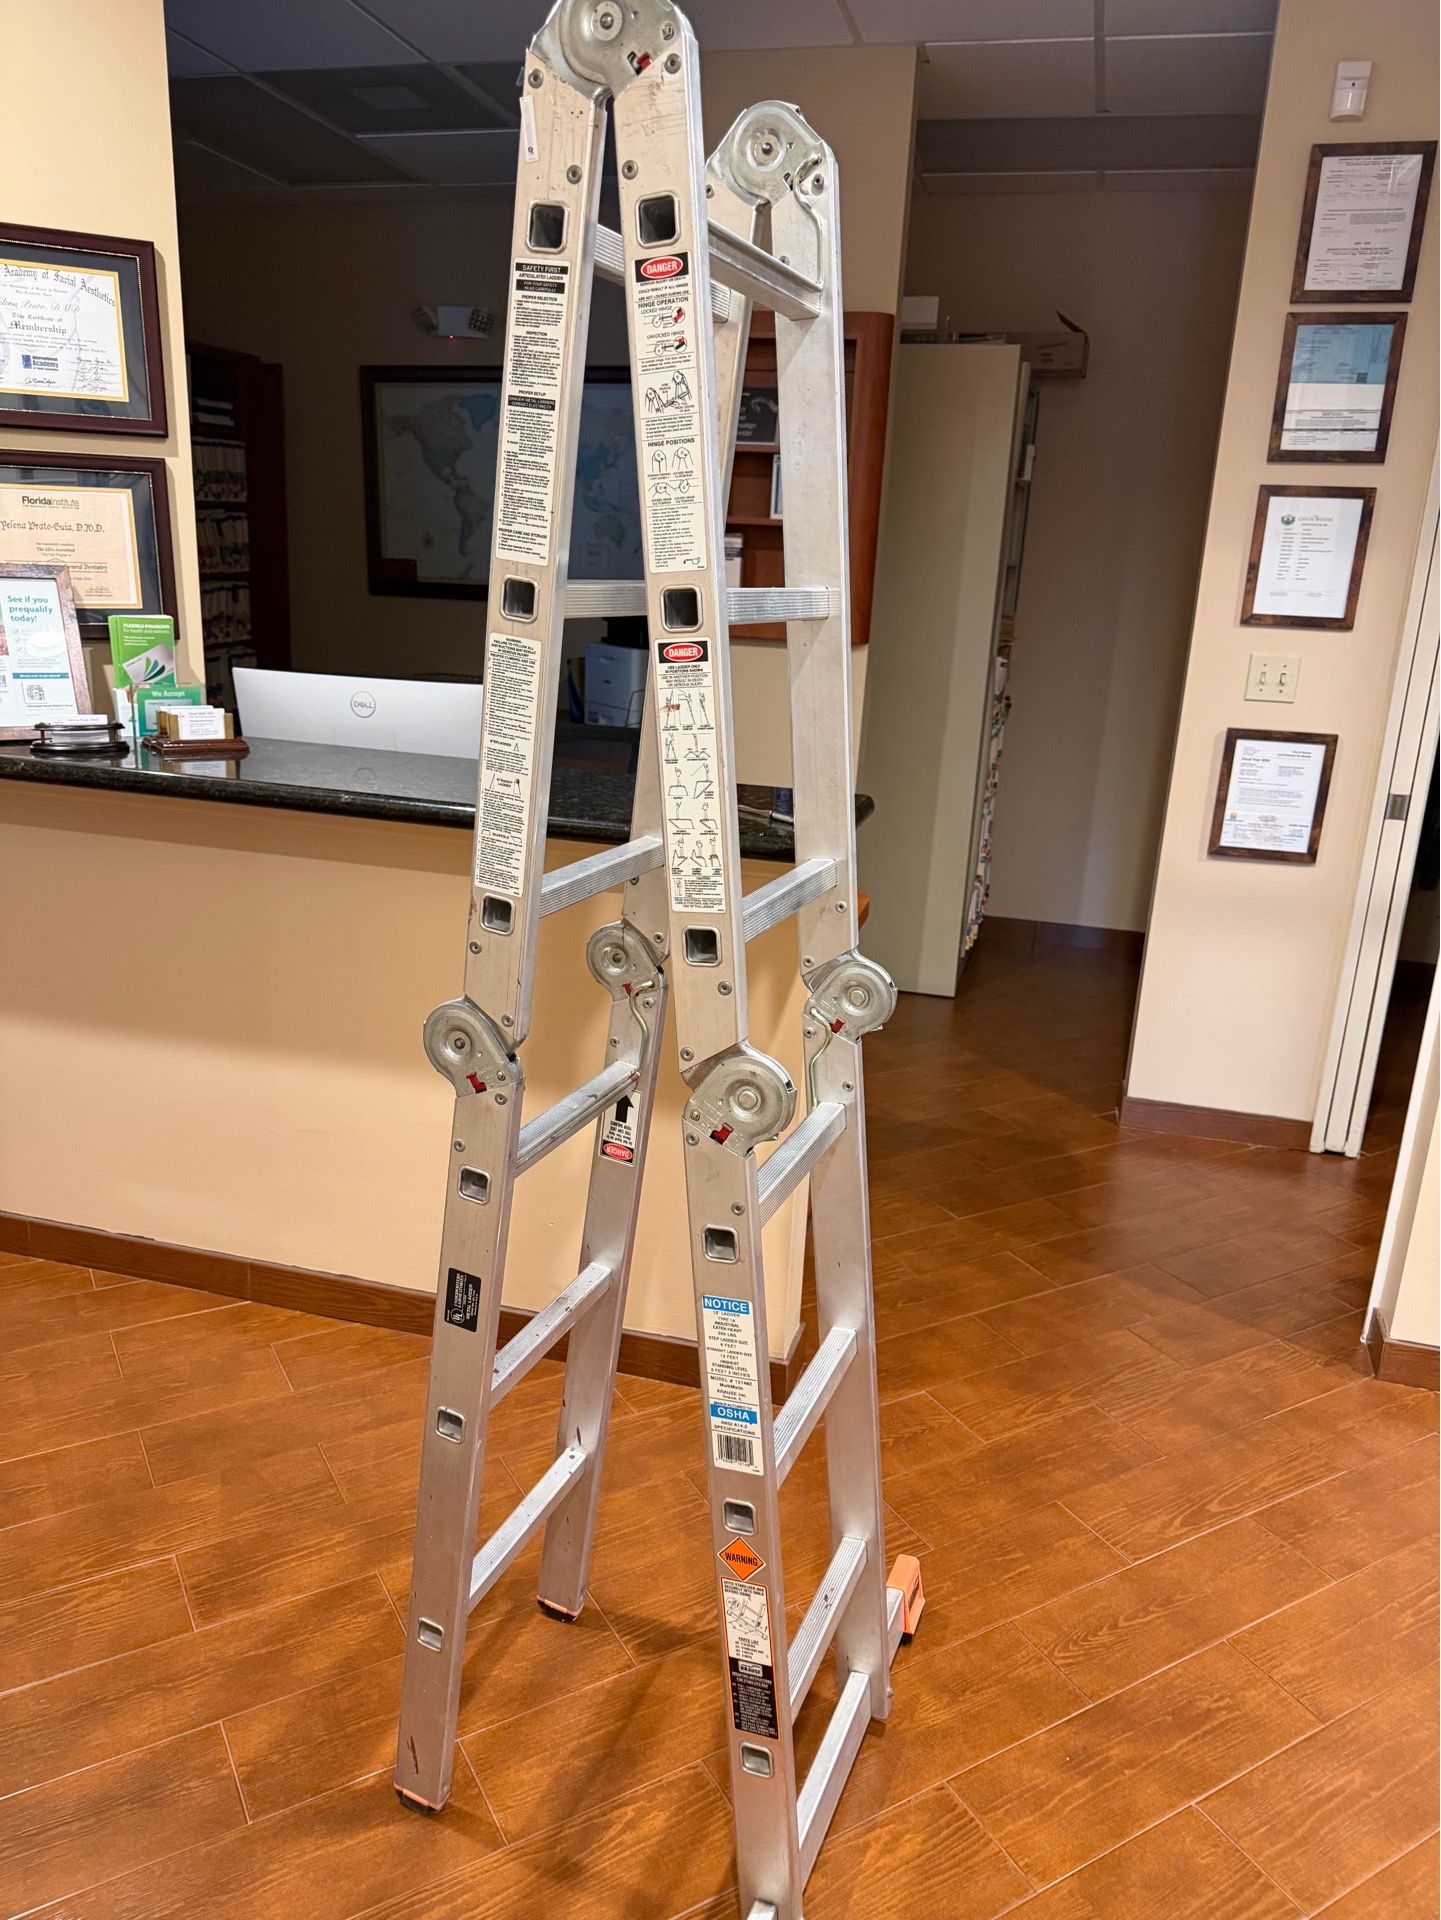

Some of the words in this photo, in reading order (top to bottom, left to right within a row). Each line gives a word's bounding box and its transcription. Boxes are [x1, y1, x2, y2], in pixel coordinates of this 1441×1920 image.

[522, 264, 544, 272] SAFETY
[647, 260, 678, 274] DANGER
[4, 264, 38, 280] Academy
[42, 269, 49, 280] of
[53, 270, 76, 288] Facial
[80, 278, 116, 307] Aesthetics
[656, 296, 689, 306] OPERATION
[8, 320, 67, 335] Membership
[666, 437, 695, 446] POSITIONS
[1, 520, 26, 531] Yelena
[8, 595, 23, 603] See
[25, 595, 31, 603] if
[32, 597, 49, 605] you
[9, 605, 53, 615] prequalify
[10, 614, 38, 623] today!
[669, 647, 698, 657] DANGER
[163, 690, 185, 698] Accept
[353, 700, 373, 709] DELL
[606, 1145, 630, 1158] DANGER
[704, 1297, 748, 1313] NOTICE
[711, 1362, 734, 1370] STANDING
[710, 1375, 728, 1383] MODEL
[717, 1407, 750, 1421] OSHA
[713, 1424, 756, 1436] SPECIFICATIONS
[724, 1552, 759, 1567] WARNING
